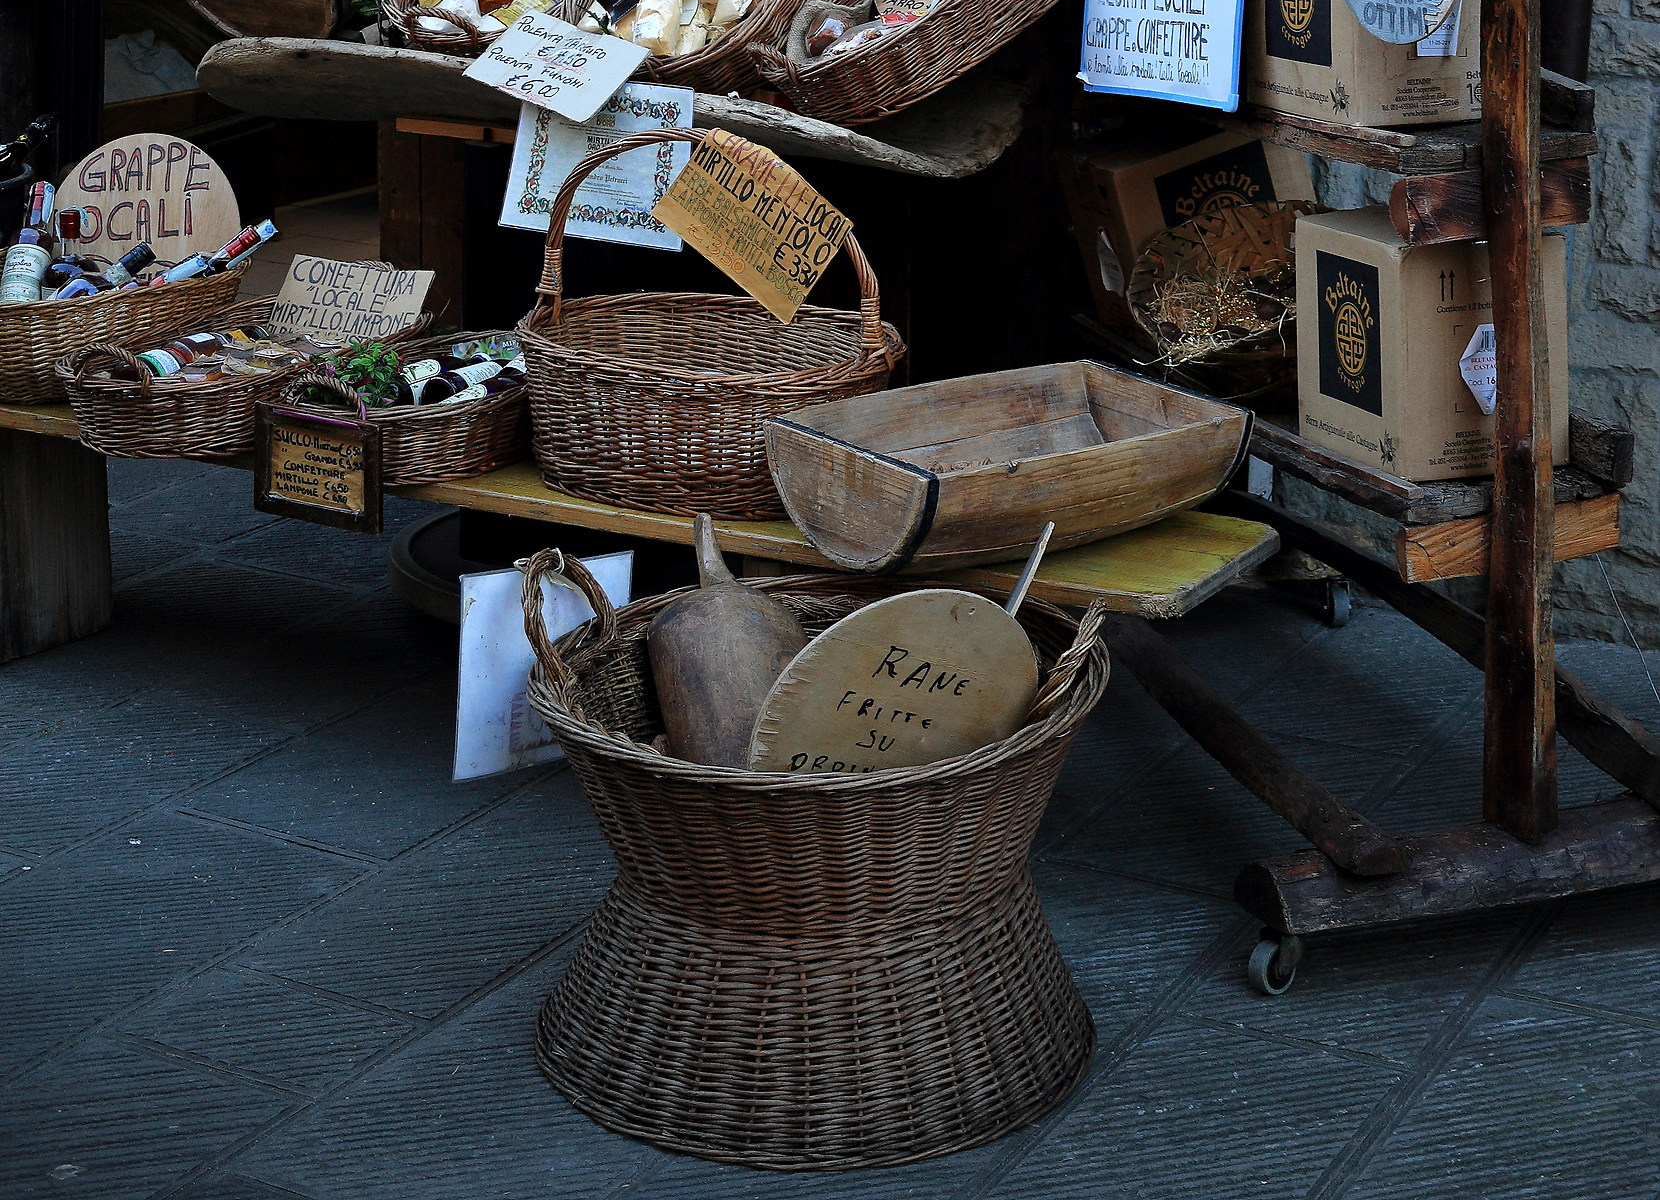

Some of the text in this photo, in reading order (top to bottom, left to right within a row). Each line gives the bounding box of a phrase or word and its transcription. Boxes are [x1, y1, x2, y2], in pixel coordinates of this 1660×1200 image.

[517, 15, 564, 43] POLENTA
[487, 47, 592, 89] POLENTA FUNGHI
[79, 141, 210, 193] GRAPPE
[680, 165, 715, 205] ERBE
[1175, 165, 1260, 216] Beltaine
[1325, 271, 1375, 329] Beltaine
[284, 460, 345, 480] CONFETTURE
[872, 645, 970, 696] RANE
[836, 691, 932, 729] FRITTE
[855, 730, 895, 751] SU
